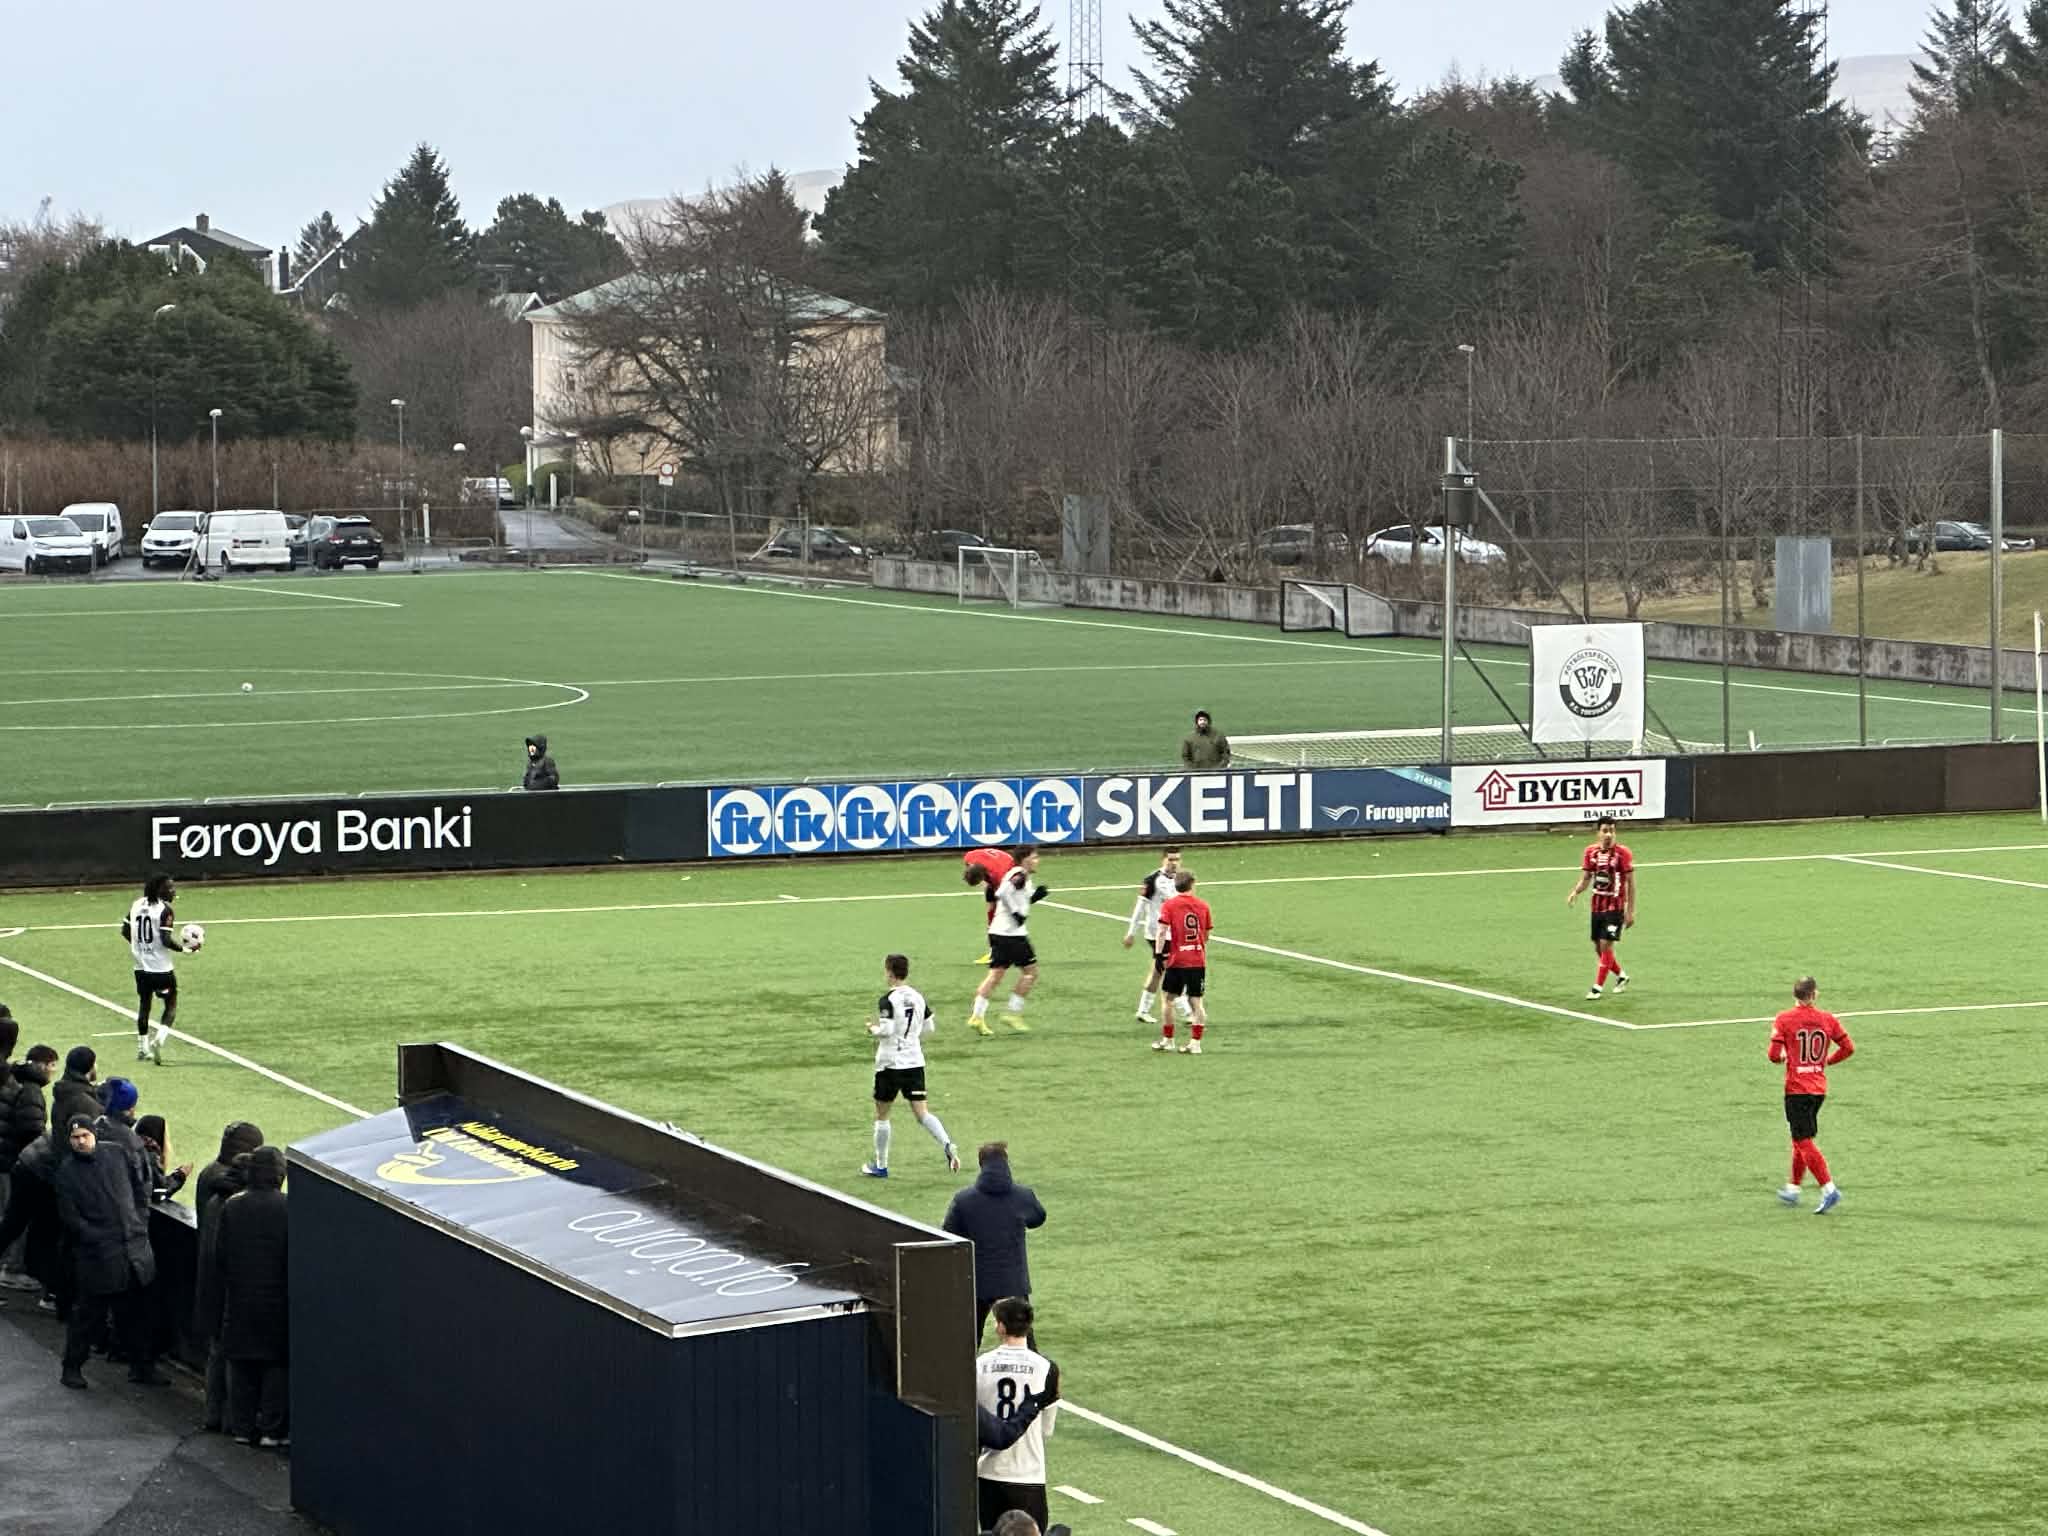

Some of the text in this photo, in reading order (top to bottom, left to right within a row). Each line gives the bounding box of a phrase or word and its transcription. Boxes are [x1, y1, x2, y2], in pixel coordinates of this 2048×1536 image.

[1573, 666, 1608, 689] B36
[1095, 773, 1313, 837] SKELTI
[1518, 777, 1634, 803] BYGMA
[714, 790, 1075, 845] fik fik fik fik fik fik
[152, 806, 473, 866] Føroya Banki
[136, 915, 153, 944] 10
[1184, 911, 1200, 942] 9
[904, 1008, 914, 1039] 7
[1796, 1029, 1826, 1064] 10
[567, 1210, 812, 1297] aurora.fo
[996, 1376, 1017, 1421] 8
